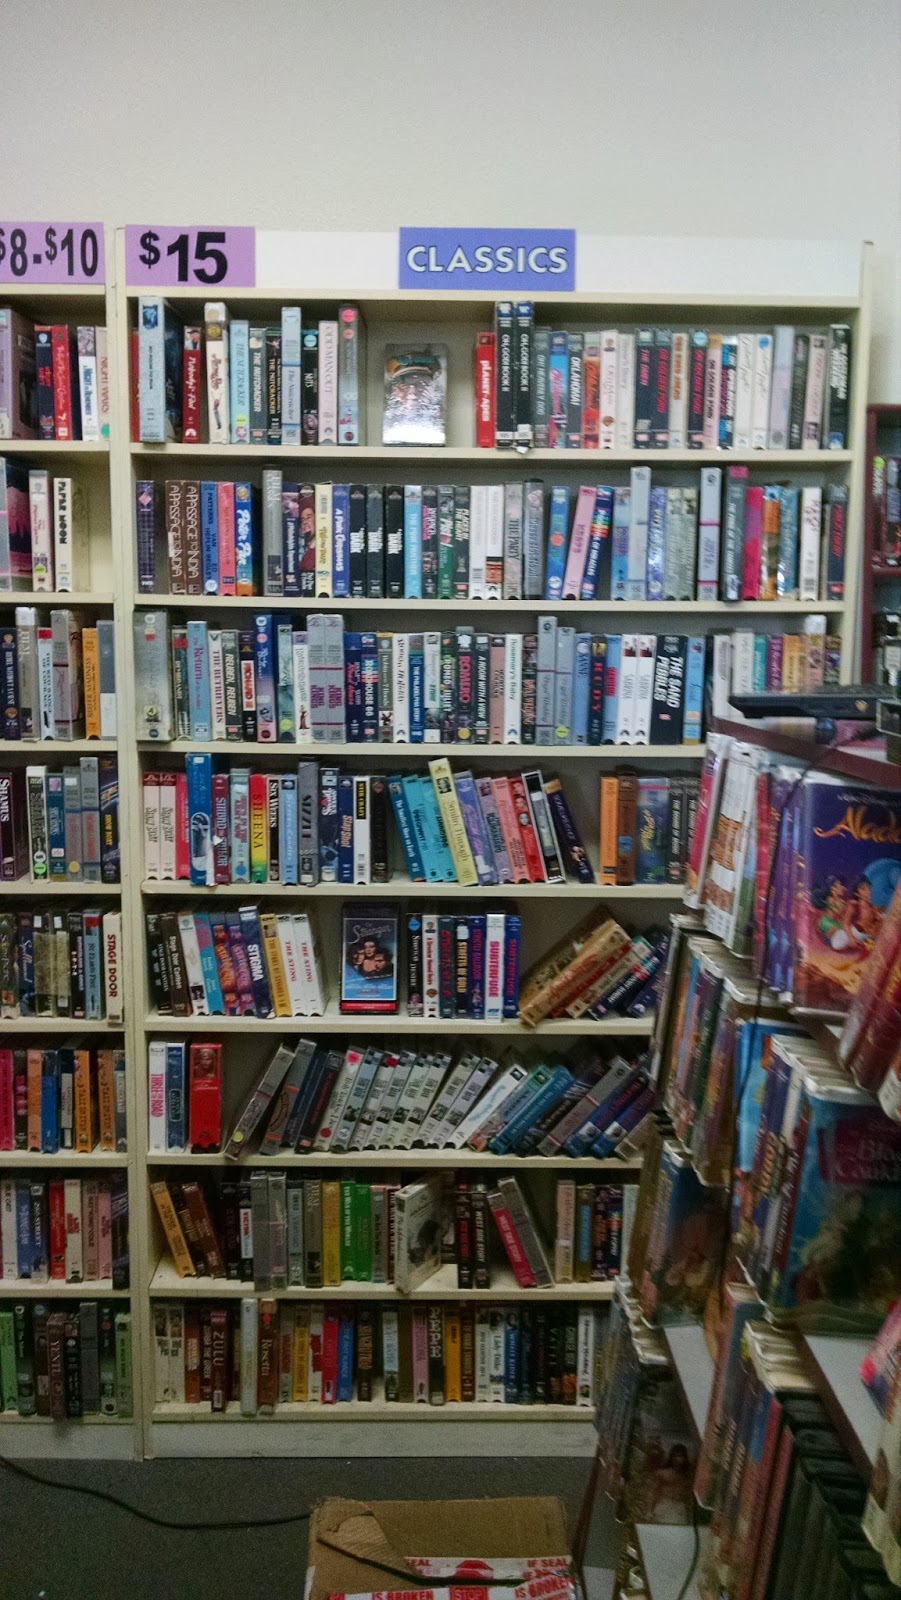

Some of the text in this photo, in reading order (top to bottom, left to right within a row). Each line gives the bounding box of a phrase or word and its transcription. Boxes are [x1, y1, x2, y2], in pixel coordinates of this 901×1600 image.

[138, 230, 229, 284] $15
[405, 245, 569, 274] CLASSICS
[252, 351, 262, 413] THE NUTCRACKER
[324, 350, 334, 373] MAN
[569, 356, 582, 406] OKLAHOMA!
[269, 371, 277, 415] NUTCRACKER
[324, 373, 334, 395] OUT
[58, 480, 68, 545] PAPER MOON
[206, 492, 214, 525] PATTERNS
[455, 508, 463, 542] THE HEART
[236, 508, 252, 566] Peter Pan
[350, 531, 360, 554] DARK
[409, 512, 418, 576] THE PINK PANTHER
[507, 518, 520, 561] THE PARTY
[187, 550, 199, 579] INDIA
[444, 657, 452, 685] ROMEO
[477, 661, 487, 681] ROOM
[509, 638, 519, 701] Rosemary's Baby
[576, 636, 589, 674] RXANNE
[213, 650, 224, 724] THE RETRIEVERS
[224, 653, 237, 716] REUBEN, REUBEN
[243, 662, 254, 701] RICHARD
[365, 659, 375, 717] ROADHOUSE 66
[413, 665, 421, 723] THE PHILADELPHIA STORY
[458, 655, 471, 704] ROMERO
[477, 680, 487, 698] WITH
[653, 655, 671, 703] PEBBLES
[666, 656, 684, 709] THE SAND
[477, 703, 487, 719] VIEW
[0, 778, 11, 822] SHAMUS
[269, 781, 279, 828] SIX WEEKS
[395, 799, 403, 809] The
[396, 808, 408, 828] Smallest
[103, 814, 113, 846] SHOW BOAT
[253, 794, 263, 850] SHEENA
[340, 831, 351, 848] Shot
[813, 805, 901, 844] Alad
[286, 829, 294, 862] Candles
[406, 845, 416, 858] Earth
[19, 936, 33, 982] Spellbound
[107, 934, 118, 997] STAGE DOOR
[168, 936, 177, 951] Stage
[173, 966, 183, 989] Canteen
[247, 943, 264, 982] STIGMA
[285, 940, 297, 983] THE STING
[301, 941, 313, 984] THE STING
[456, 941, 469, 994] STREETS OF GOLD
[489, 940, 500, 998] SUBTERFUGE
[507, 938, 517, 997] SUBTERFUGE
[150, 1073, 164, 1118] THREE ROAD
[344, 1196, 352, 1208] WAR
[344, 1208, 352, 1216] OF
[476, 1210, 485, 1228] WEST
[344, 1225, 352, 1247] WORLDS
[476, 1228, 485, 1243] SIDE
[499, 1215, 511, 1232] WEST
[508, 1243, 523, 1263] STORY
[212, 1330, 225, 1367] ZULU
[261, 1338, 273, 1377] Rosetta
